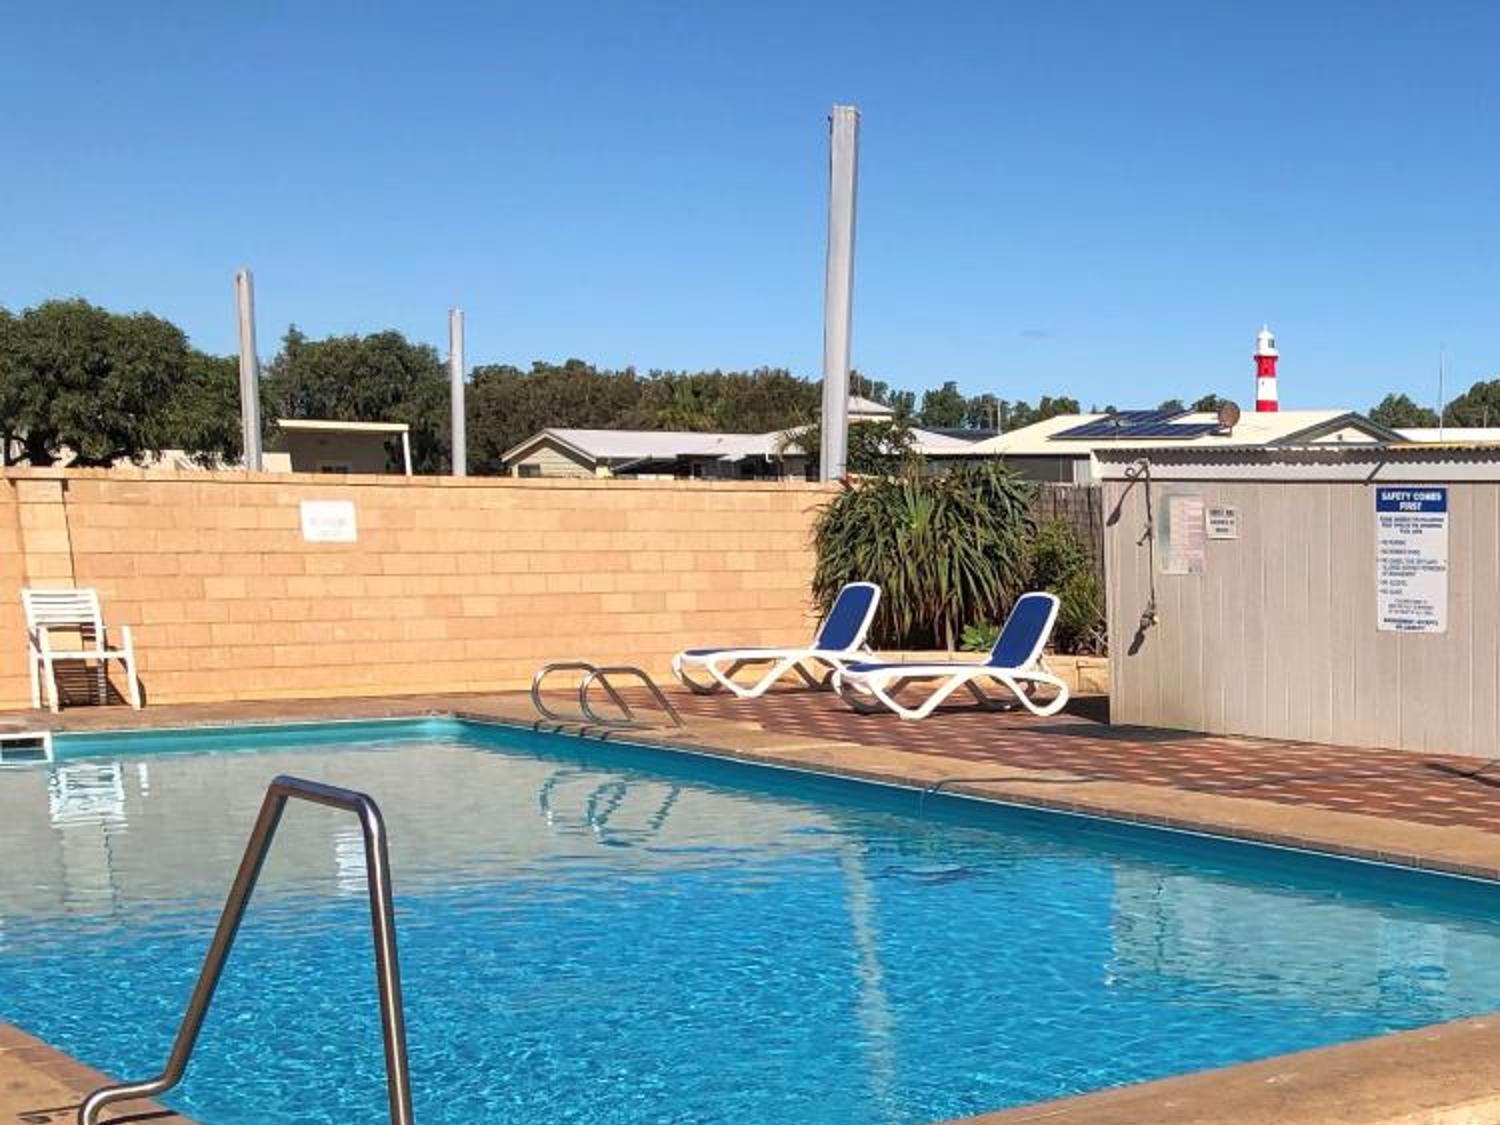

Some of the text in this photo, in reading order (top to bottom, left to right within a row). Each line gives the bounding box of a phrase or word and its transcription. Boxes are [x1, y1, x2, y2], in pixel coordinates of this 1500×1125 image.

[1381, 491, 1442, 501] SAFETY COMES
[1399, 501, 1422, 511] FIRST
